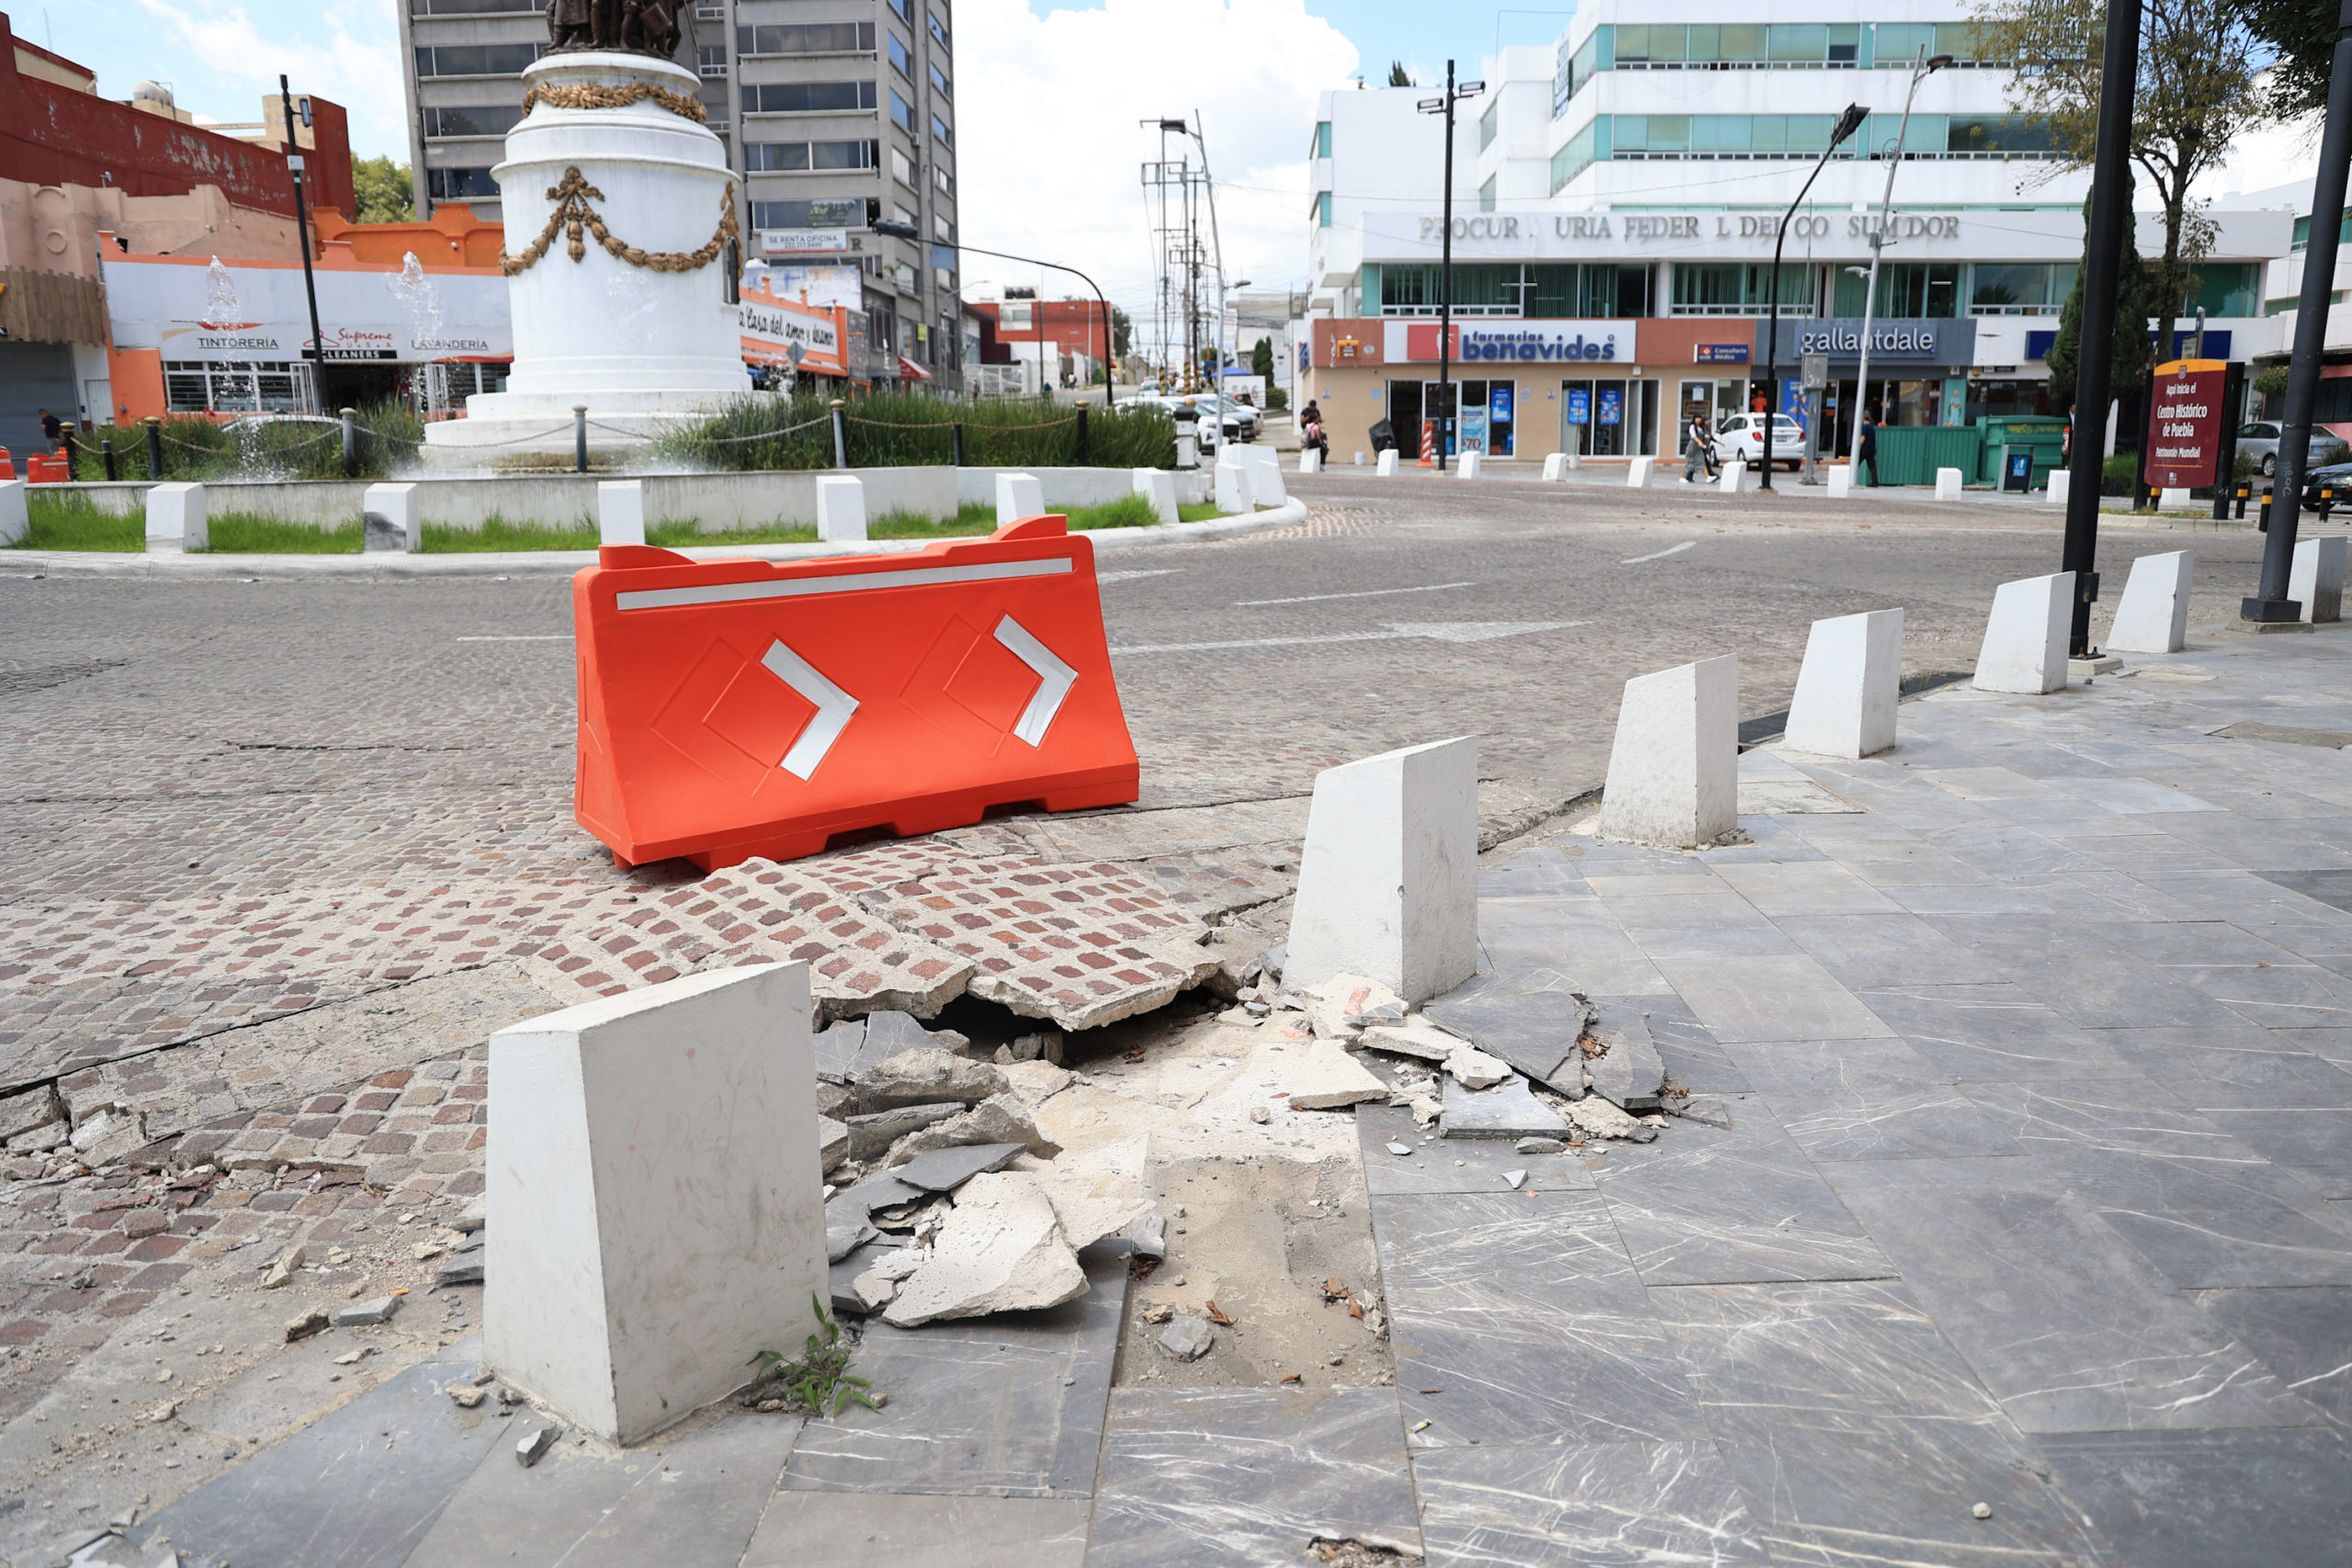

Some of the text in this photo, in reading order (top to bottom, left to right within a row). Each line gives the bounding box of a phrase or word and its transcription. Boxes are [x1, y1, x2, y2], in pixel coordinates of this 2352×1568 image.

[1555, 216, 1611, 239] URIA
[1623, 216, 1700, 238] FEDER
[807, 234, 838, 243] OFICINA
[745, 306, 768, 333] Casa
[769, 313, 784, 337] del
[785, 321, 805, 341] amor
[197, 336, 279, 349] TINTORERÍA
[338, 327, 393, 343] Supreme
[1472, 331, 1544, 342] farmacias
[322, 350, 380, 359] CLEANERS
[1463, 333, 1615, 361] benavides
[2156, 402, 2208, 419] Centro Histórico
[2162, 422, 2194, 437] de Puebla
[2178, 446, 2201, 458] Mundial
